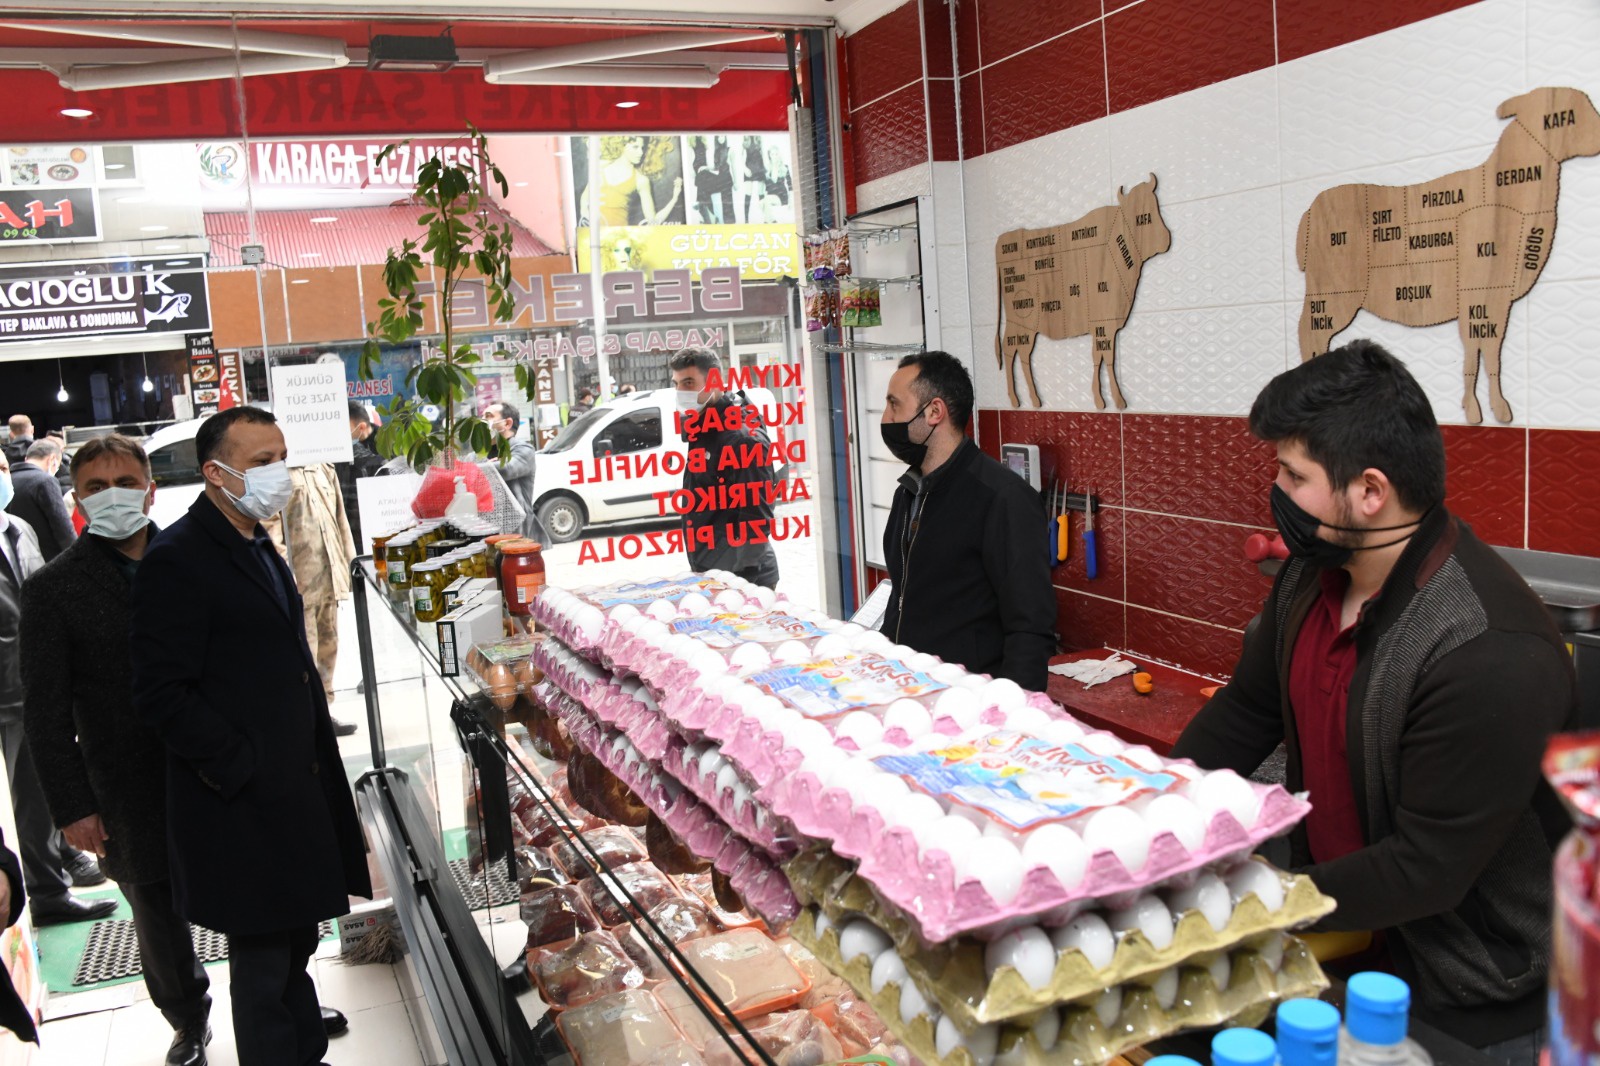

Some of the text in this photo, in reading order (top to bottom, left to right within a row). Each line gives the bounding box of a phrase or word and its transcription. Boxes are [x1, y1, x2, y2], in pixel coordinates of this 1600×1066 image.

[1543, 109, 1576, 131] KAFA
[256, 143, 361, 185] KARACA
[1496, 165, 1542, 187] GERDAN
[1422, 188, 1465, 209] PİRZOLA
[1135, 213, 1152, 227] KAFA
[1372, 209, 1392, 225] SIRT
[670, 230, 791, 252] GÜLCAN
[1071, 226, 1098, 241] ANTRİKOT
[1330, 231, 1347, 247] BUT
[1373, 224, 1401, 244] FİLETO
[1409, 231, 1454, 251] KABURGA
[1026, 234, 1056, 250] KONTRAFİLE
[1476, 241, 1498, 257] KOL
[1524, 227, 1545, 271] GÖĞÜS
[1116, 234, 1134, 270] GERDAN
[1034, 257, 1055, 271] BONFİLE
[1069, 284, 1081, 298] DÖŞ
[1097, 281, 1109, 293] KOL
[1395, 285, 1432, 303] BOŞLUK
[1012, 298, 1034, 311] YUMURTA
[1310, 300, 1326, 314] BUT
[1468, 304, 1489, 320] KOL
[22, 314, 68, 331] BAKLAVA
[70, 314, 78, 328] &
[80, 310, 139, 327] DONDURMA
[1310, 312, 1334, 330] İNCİK
[1095, 326, 1106, 337] KOL
[1469, 319, 1498, 339] İNCİK
[1007, 336, 1016, 346] BUT
[1096, 337, 1112, 351] İNCİK
